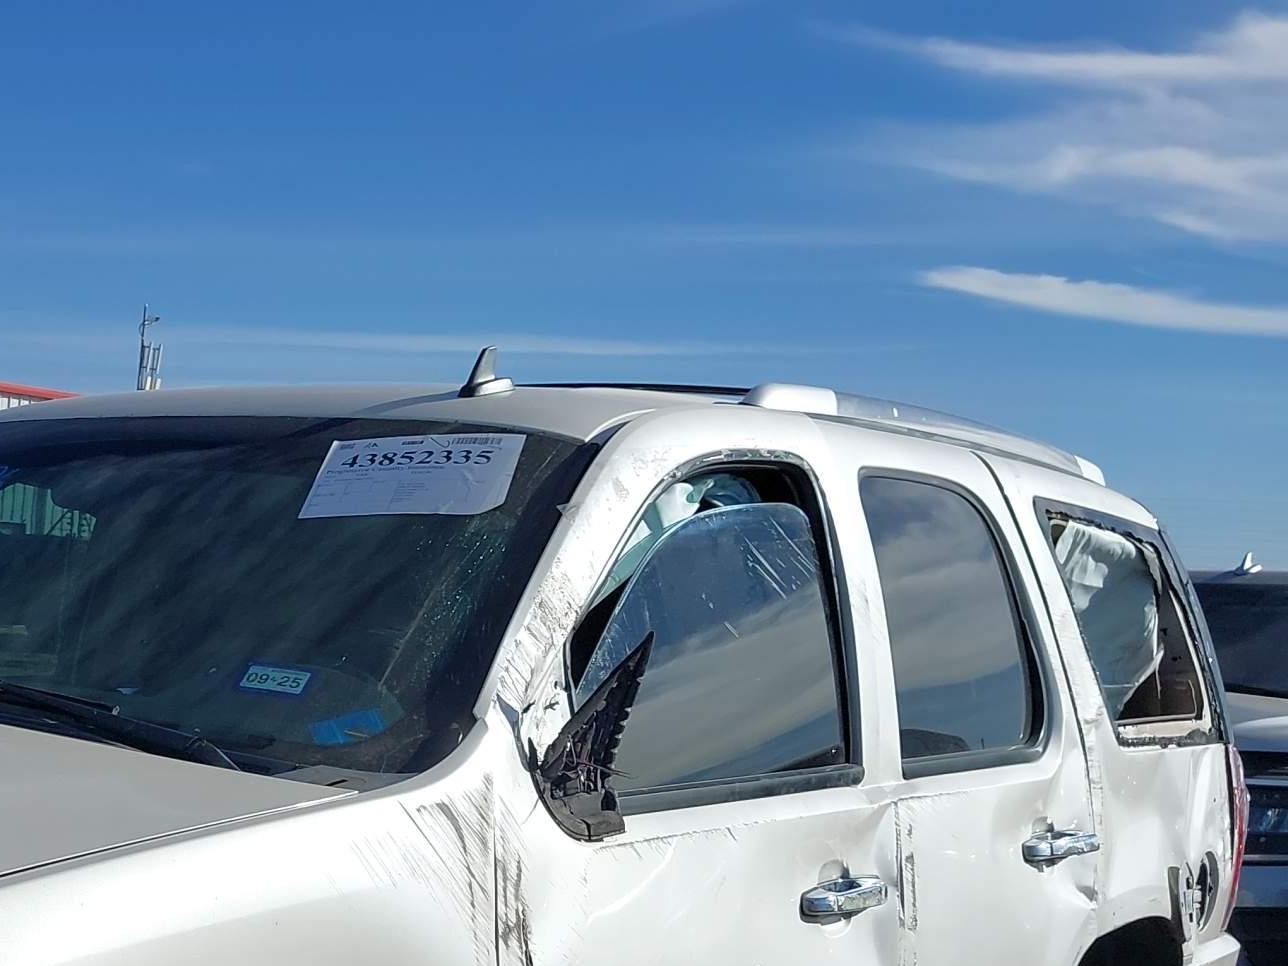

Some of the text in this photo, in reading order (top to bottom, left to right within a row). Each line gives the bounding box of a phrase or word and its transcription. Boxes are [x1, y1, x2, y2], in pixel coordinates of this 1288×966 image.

[340, 450, 495, 468] 43852335
[247, 672, 303, 689] 09 25
